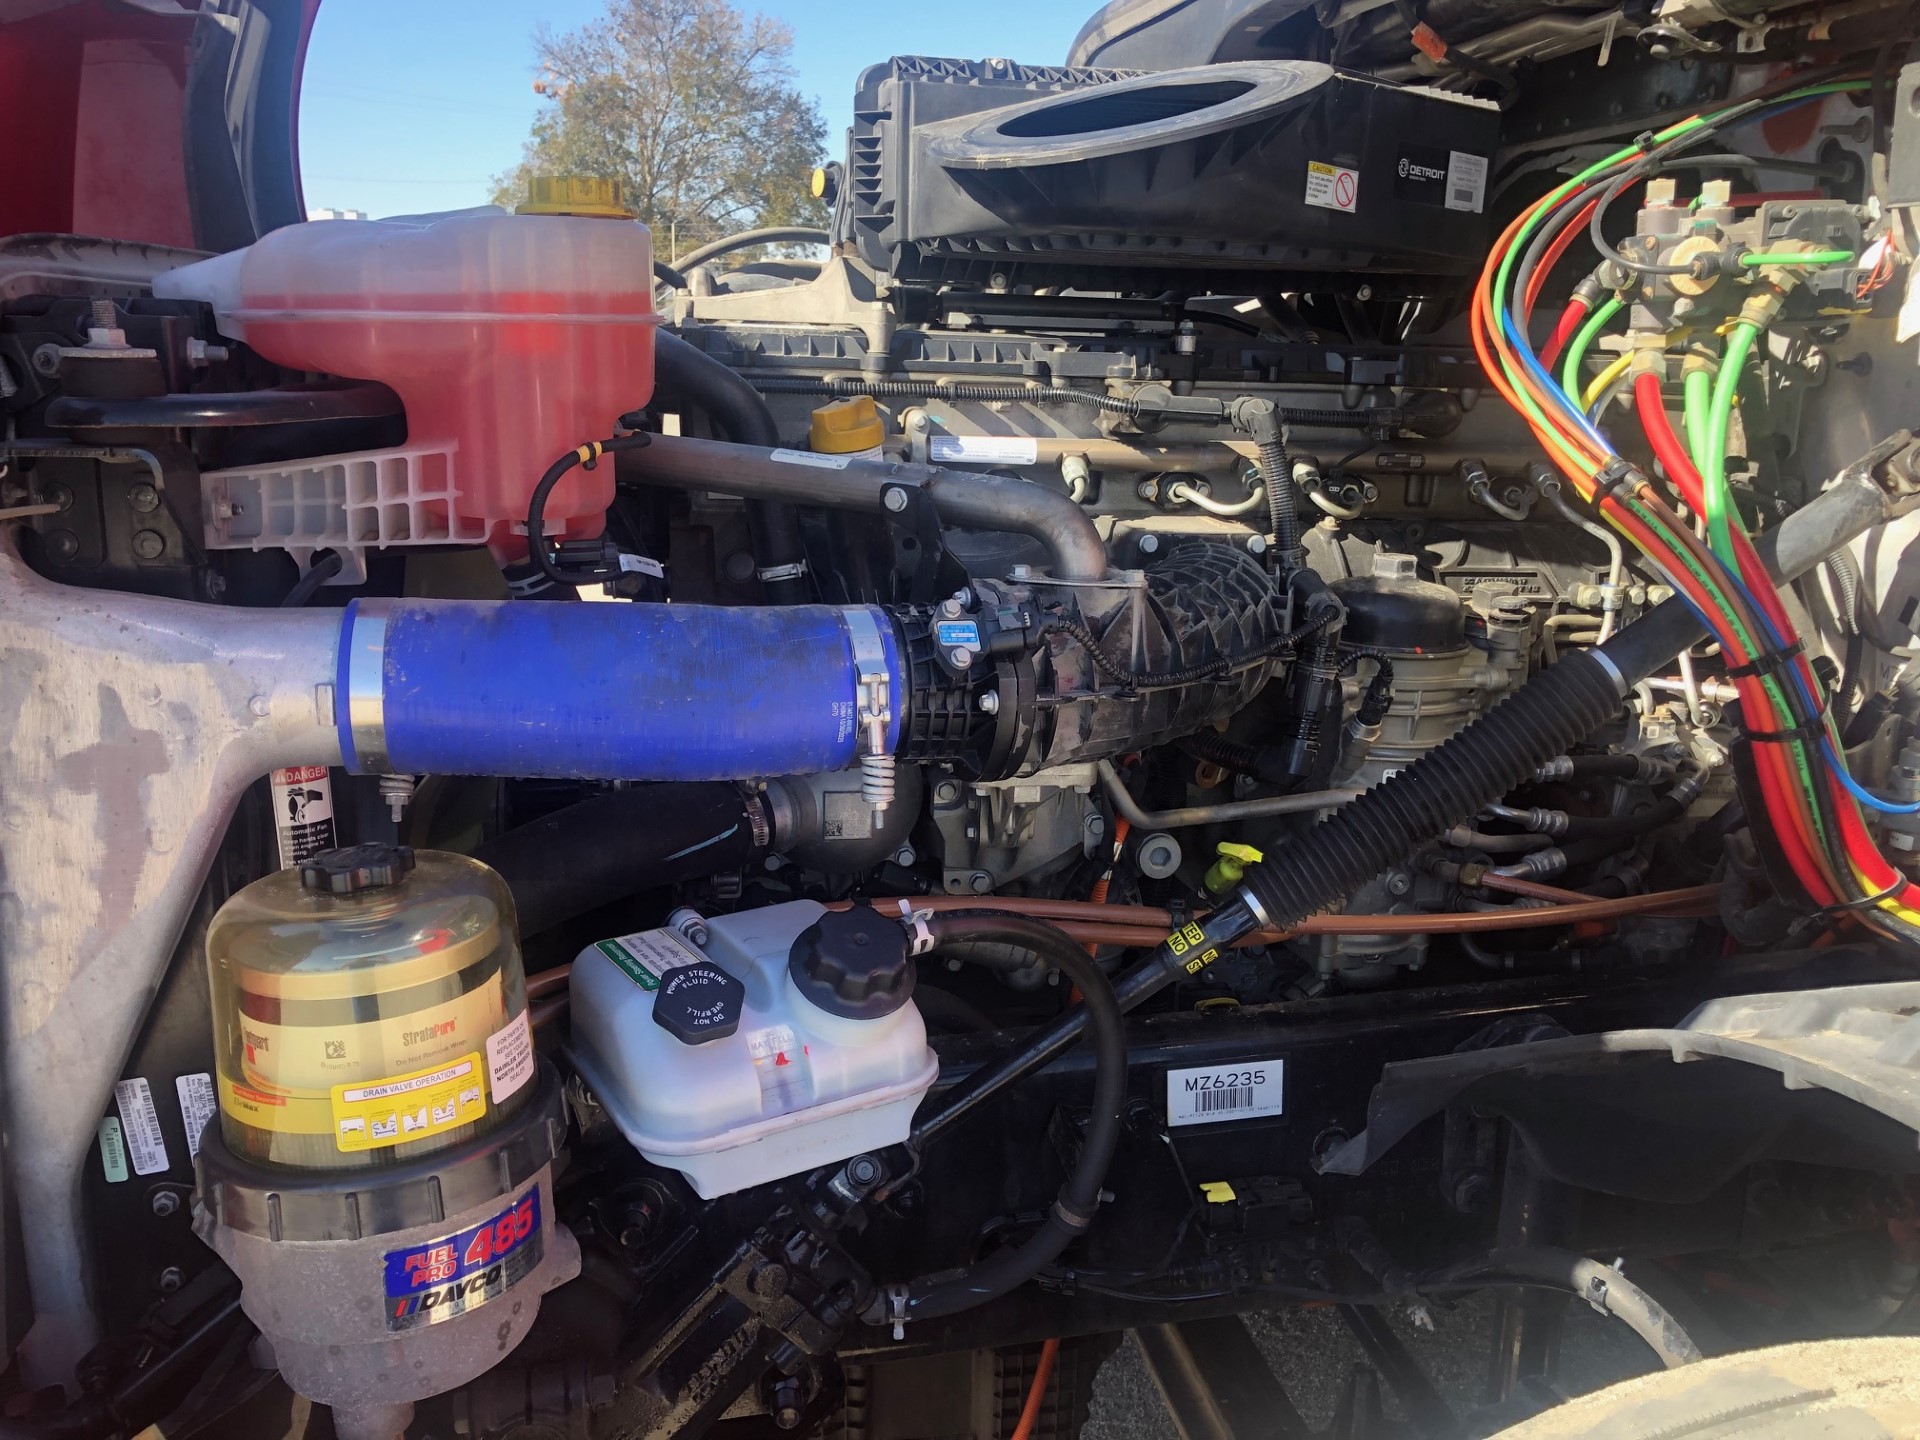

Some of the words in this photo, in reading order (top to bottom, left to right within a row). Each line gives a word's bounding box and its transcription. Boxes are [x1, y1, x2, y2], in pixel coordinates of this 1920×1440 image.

[1312, 164, 1333, 175] CAUTION
[1409, 166, 1446, 181] DETROIT
[286, 767, 327, 782] DANGER
[282, 826, 316, 836] Automatic
[316, 823, 328, 832] Fan
[299, 835, 316, 843] hands
[300, 841, 319, 849] engine
[1169, 935, 1186, 952] NO
[666, 974, 686, 995] POWER
[688, 969, 727, 986] STEERING
[681, 978, 709, 989] FLUID
[686, 1001, 724, 1018] OVERFILL
[713, 1013, 725, 1023] DO
[402, 1019, 456, 1047] StrataPore
[497, 1036, 507, 1046] FOR
[507, 1026, 519, 1041] PARTS
[408, 1054, 422, 1064] Not
[422, 1046, 450, 1060] Remove
[504, 1049, 513, 1060] SEE
[513, 1040, 524, 1052] YOUR
[494, 1055, 517, 1075] DAIMLER
[496, 1065, 515, 1082] NORTH
[509, 1065, 526, 1083] DEALER
[363, 1088, 388, 1098] DRAIN
[389, 1081, 414, 1093] VALVE
[415, 1068, 457, 1087] OPERATION
[1185, 1070, 1266, 1092] MZ6235
[464, 1198, 534, 1265] 485
[405, 1243, 458, 1272] FUEL
[411, 1260, 457, 1287] PRO
[419, 1264, 502, 1312] DAYCO
